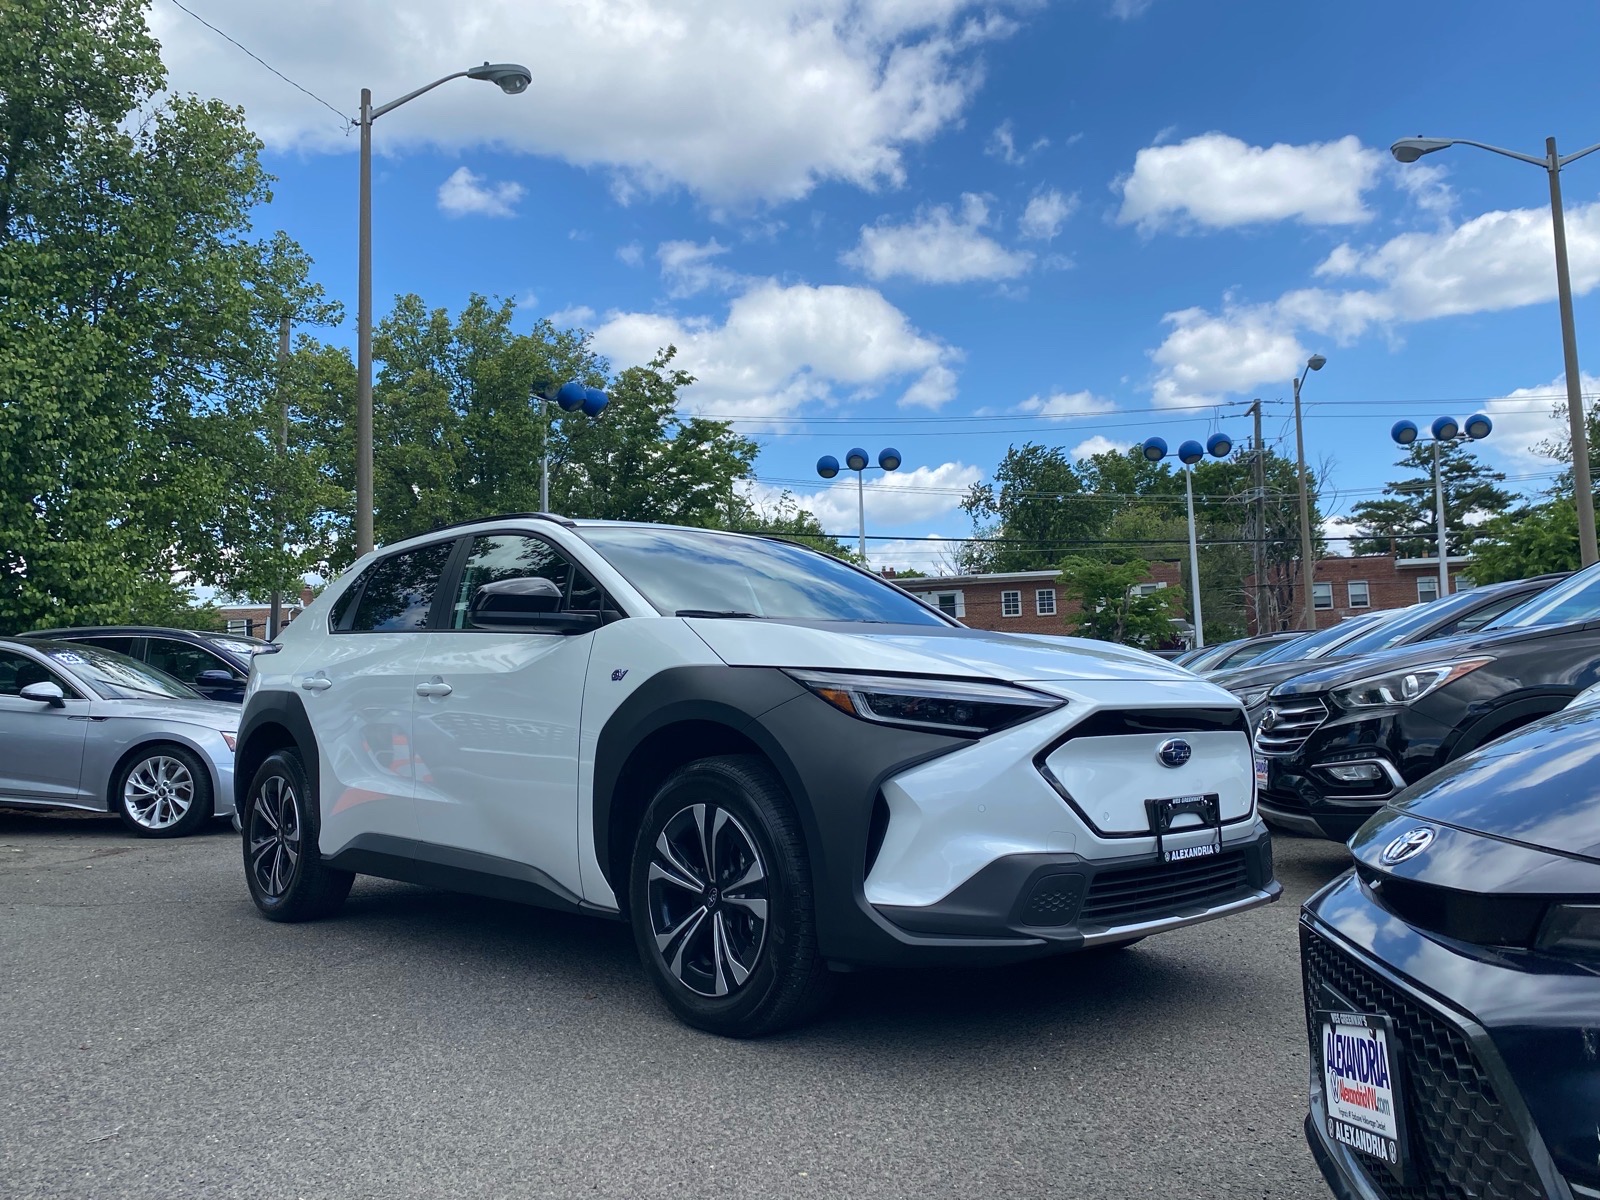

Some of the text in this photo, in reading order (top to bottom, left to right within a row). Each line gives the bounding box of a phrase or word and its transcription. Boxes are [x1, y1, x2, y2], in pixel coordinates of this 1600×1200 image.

[1171, 845, 1214, 861] ALEXANDRIA
[1327, 1032, 1391, 1090] ALEXANDRIA
[1335, 1121, 1388, 1161] ALEXANDRIA
